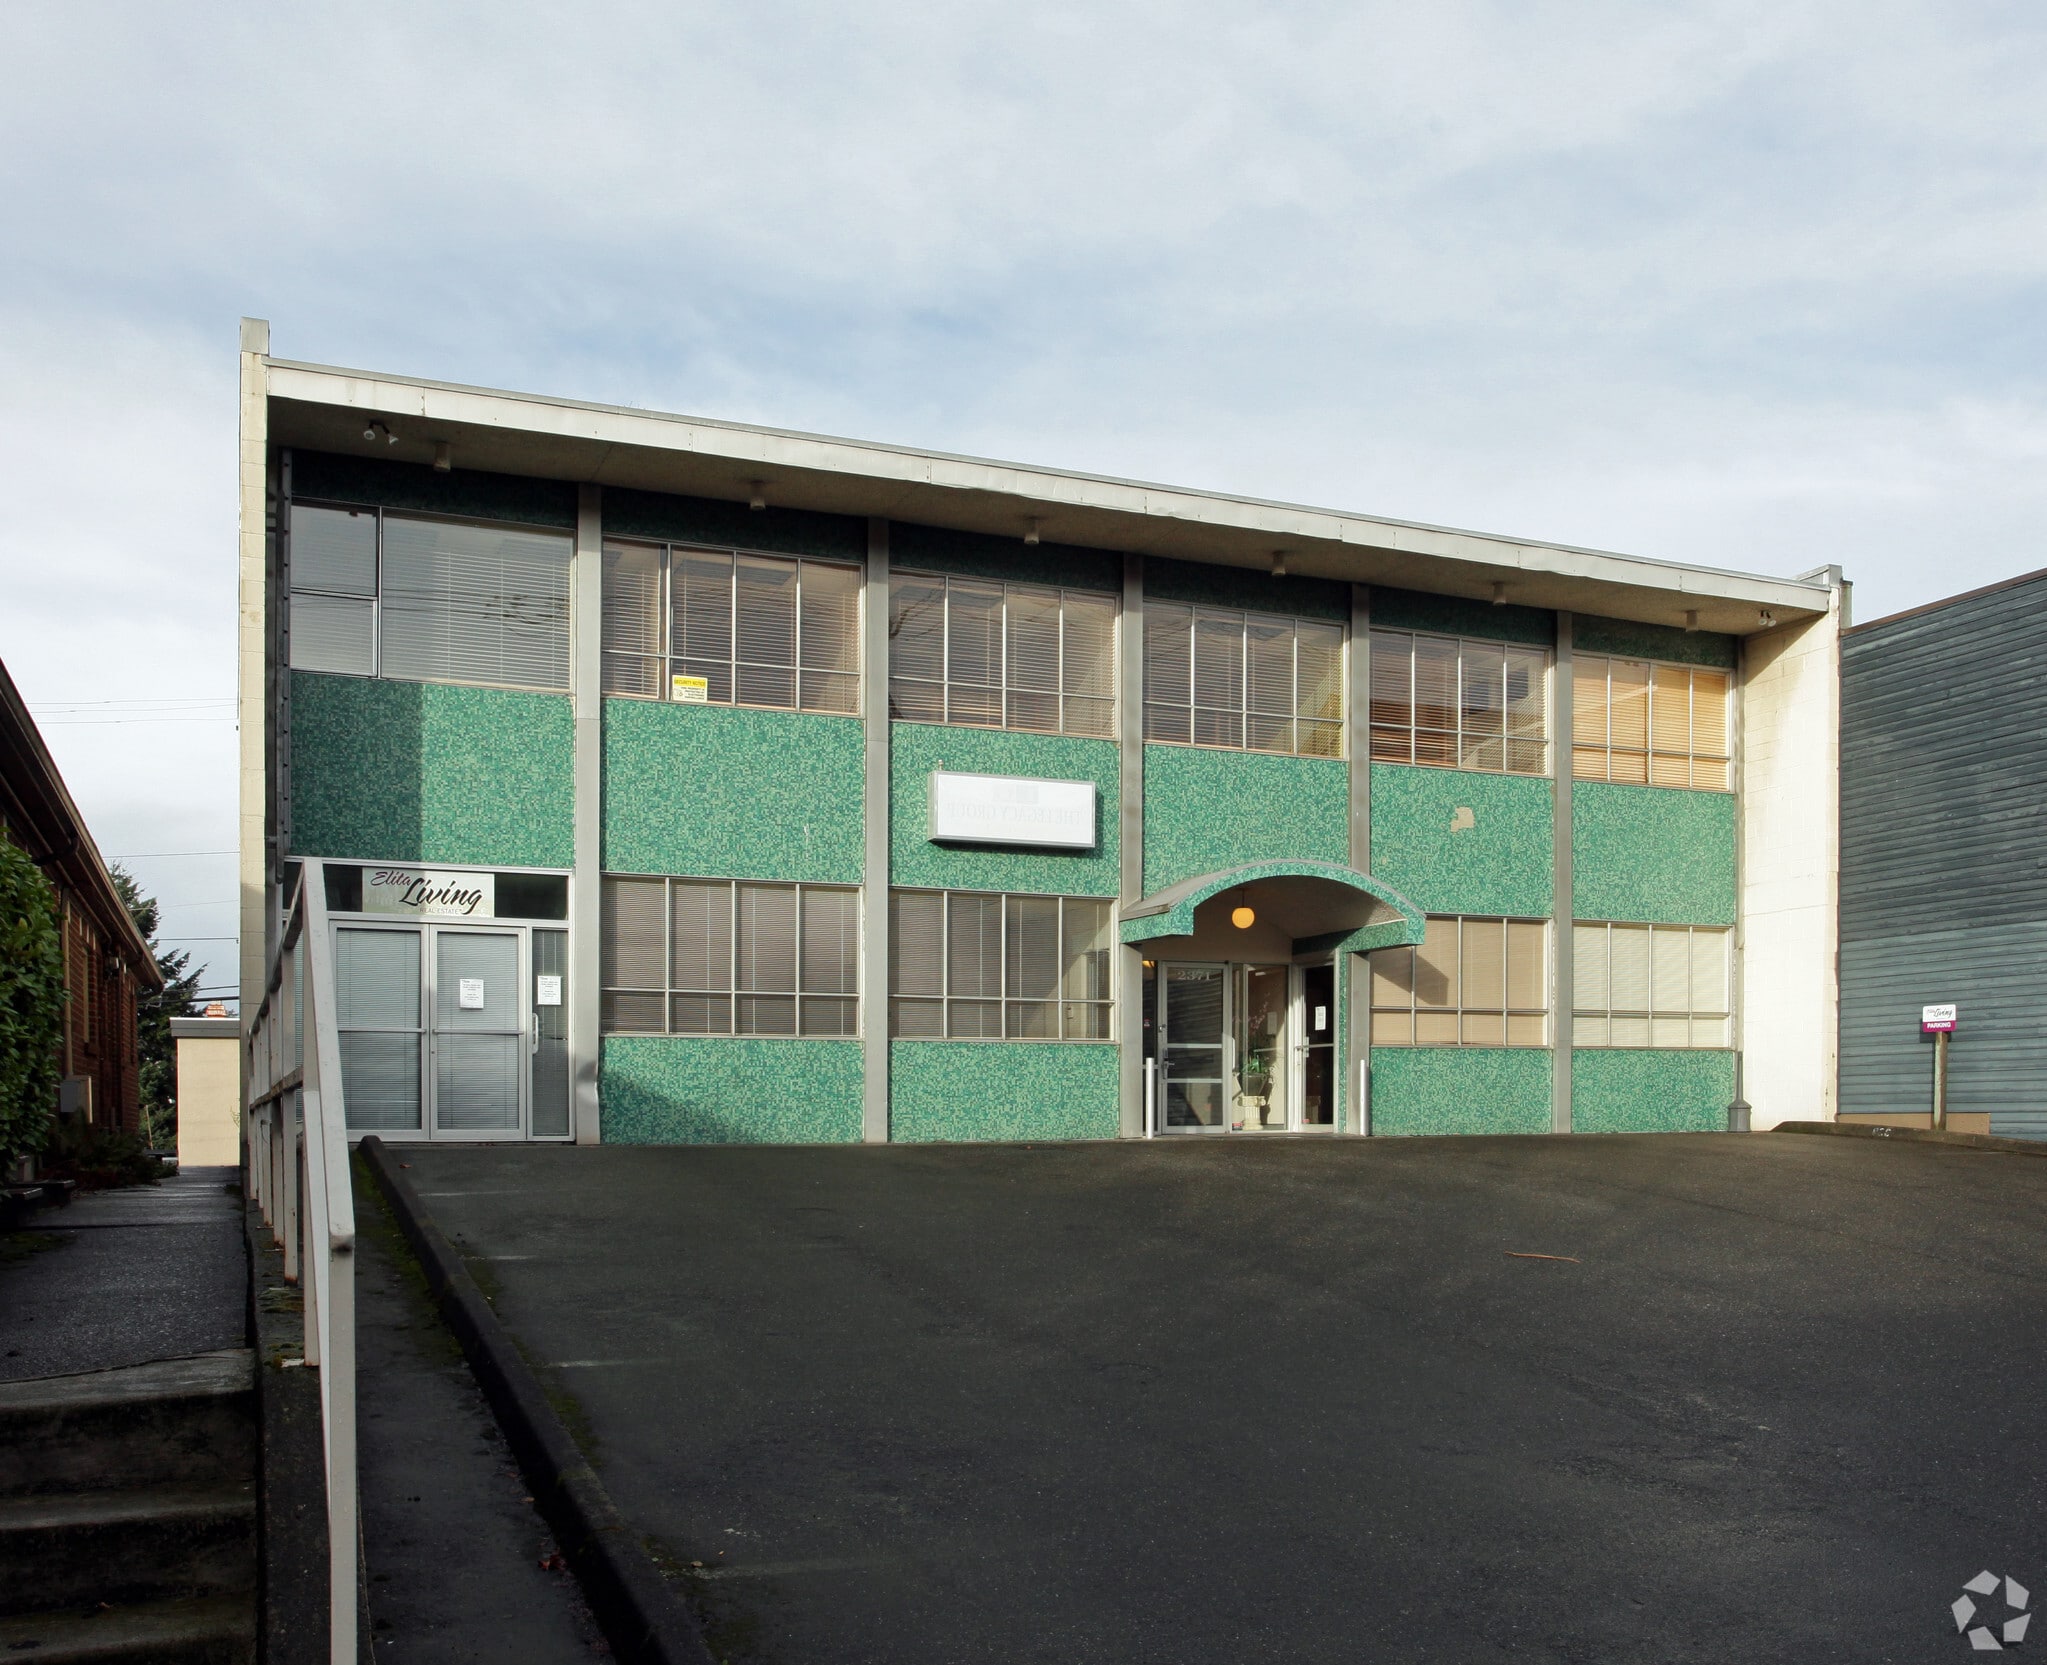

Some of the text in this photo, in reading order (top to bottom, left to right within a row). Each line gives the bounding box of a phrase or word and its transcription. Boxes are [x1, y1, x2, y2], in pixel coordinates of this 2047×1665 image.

[370, 870, 412, 888] Elita
[399, 877, 483, 915] Living
[1176, 970, 1211, 981] 2371
